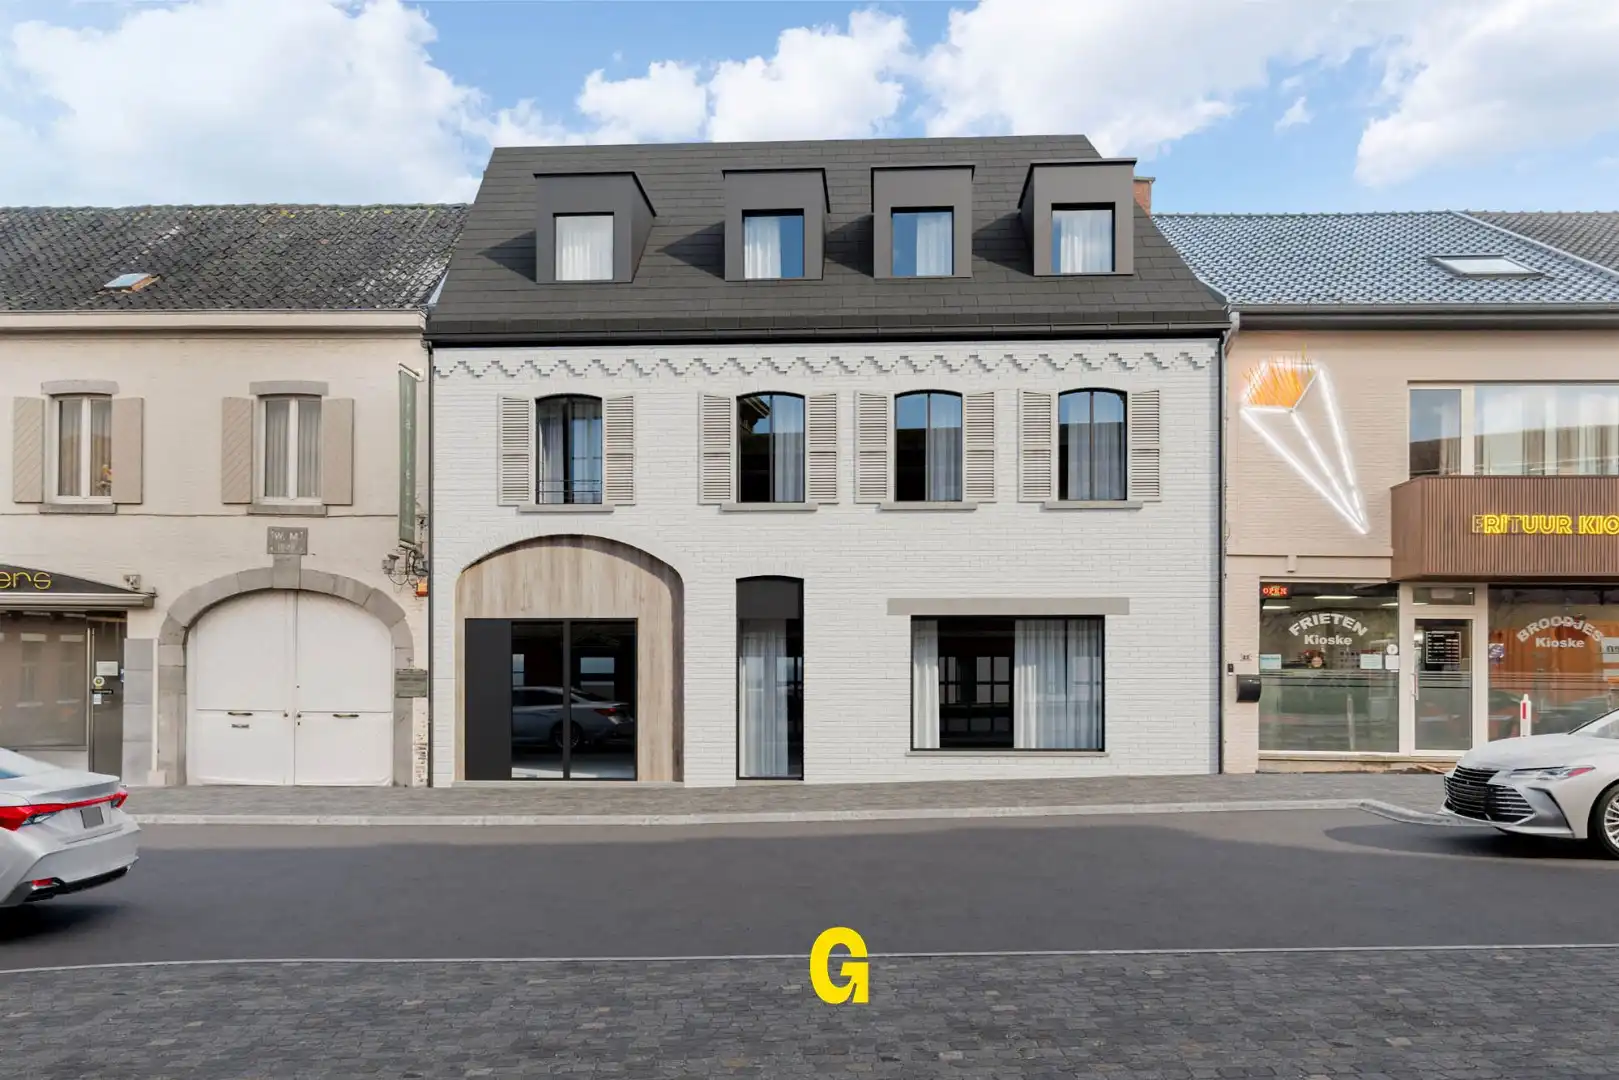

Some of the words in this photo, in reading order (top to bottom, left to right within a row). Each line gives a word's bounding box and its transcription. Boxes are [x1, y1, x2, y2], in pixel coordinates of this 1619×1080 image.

[1471, 514, 1572, 535] FRITUUR
[1578, 514, 1619, 535] KIO
[1262, 586, 1288, 596] OPEN
[1288, 613, 1369, 636] FRIETEN
[1516, 615, 1605, 642] BROODJES
[1304, 634, 1353, 645] Kioske
[1535, 637, 1585, 648] Kioske
